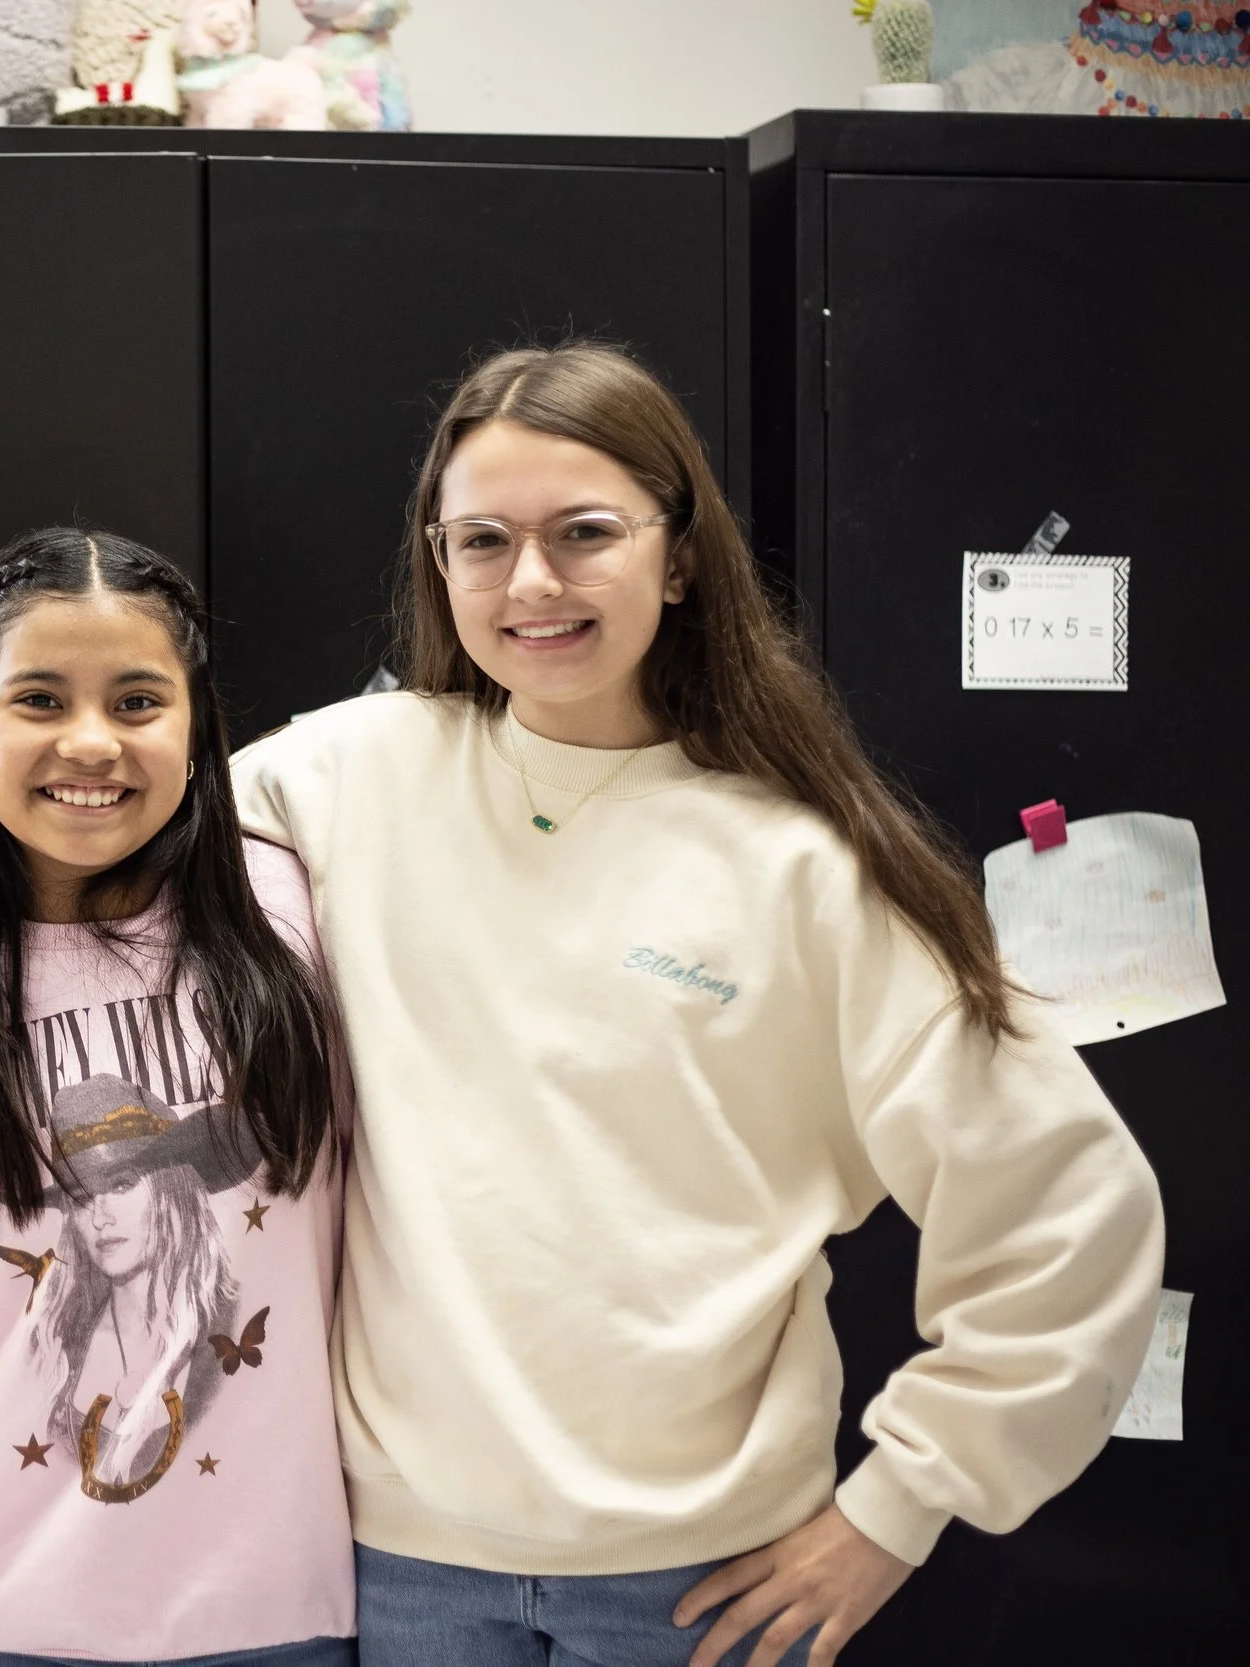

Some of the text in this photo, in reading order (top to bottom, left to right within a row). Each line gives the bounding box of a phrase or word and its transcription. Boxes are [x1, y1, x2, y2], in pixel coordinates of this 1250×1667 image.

[984, 616, 998, 638] 0
[1010, 616, 1031, 638] 17
[1064, 616, 1079, 639] 5
